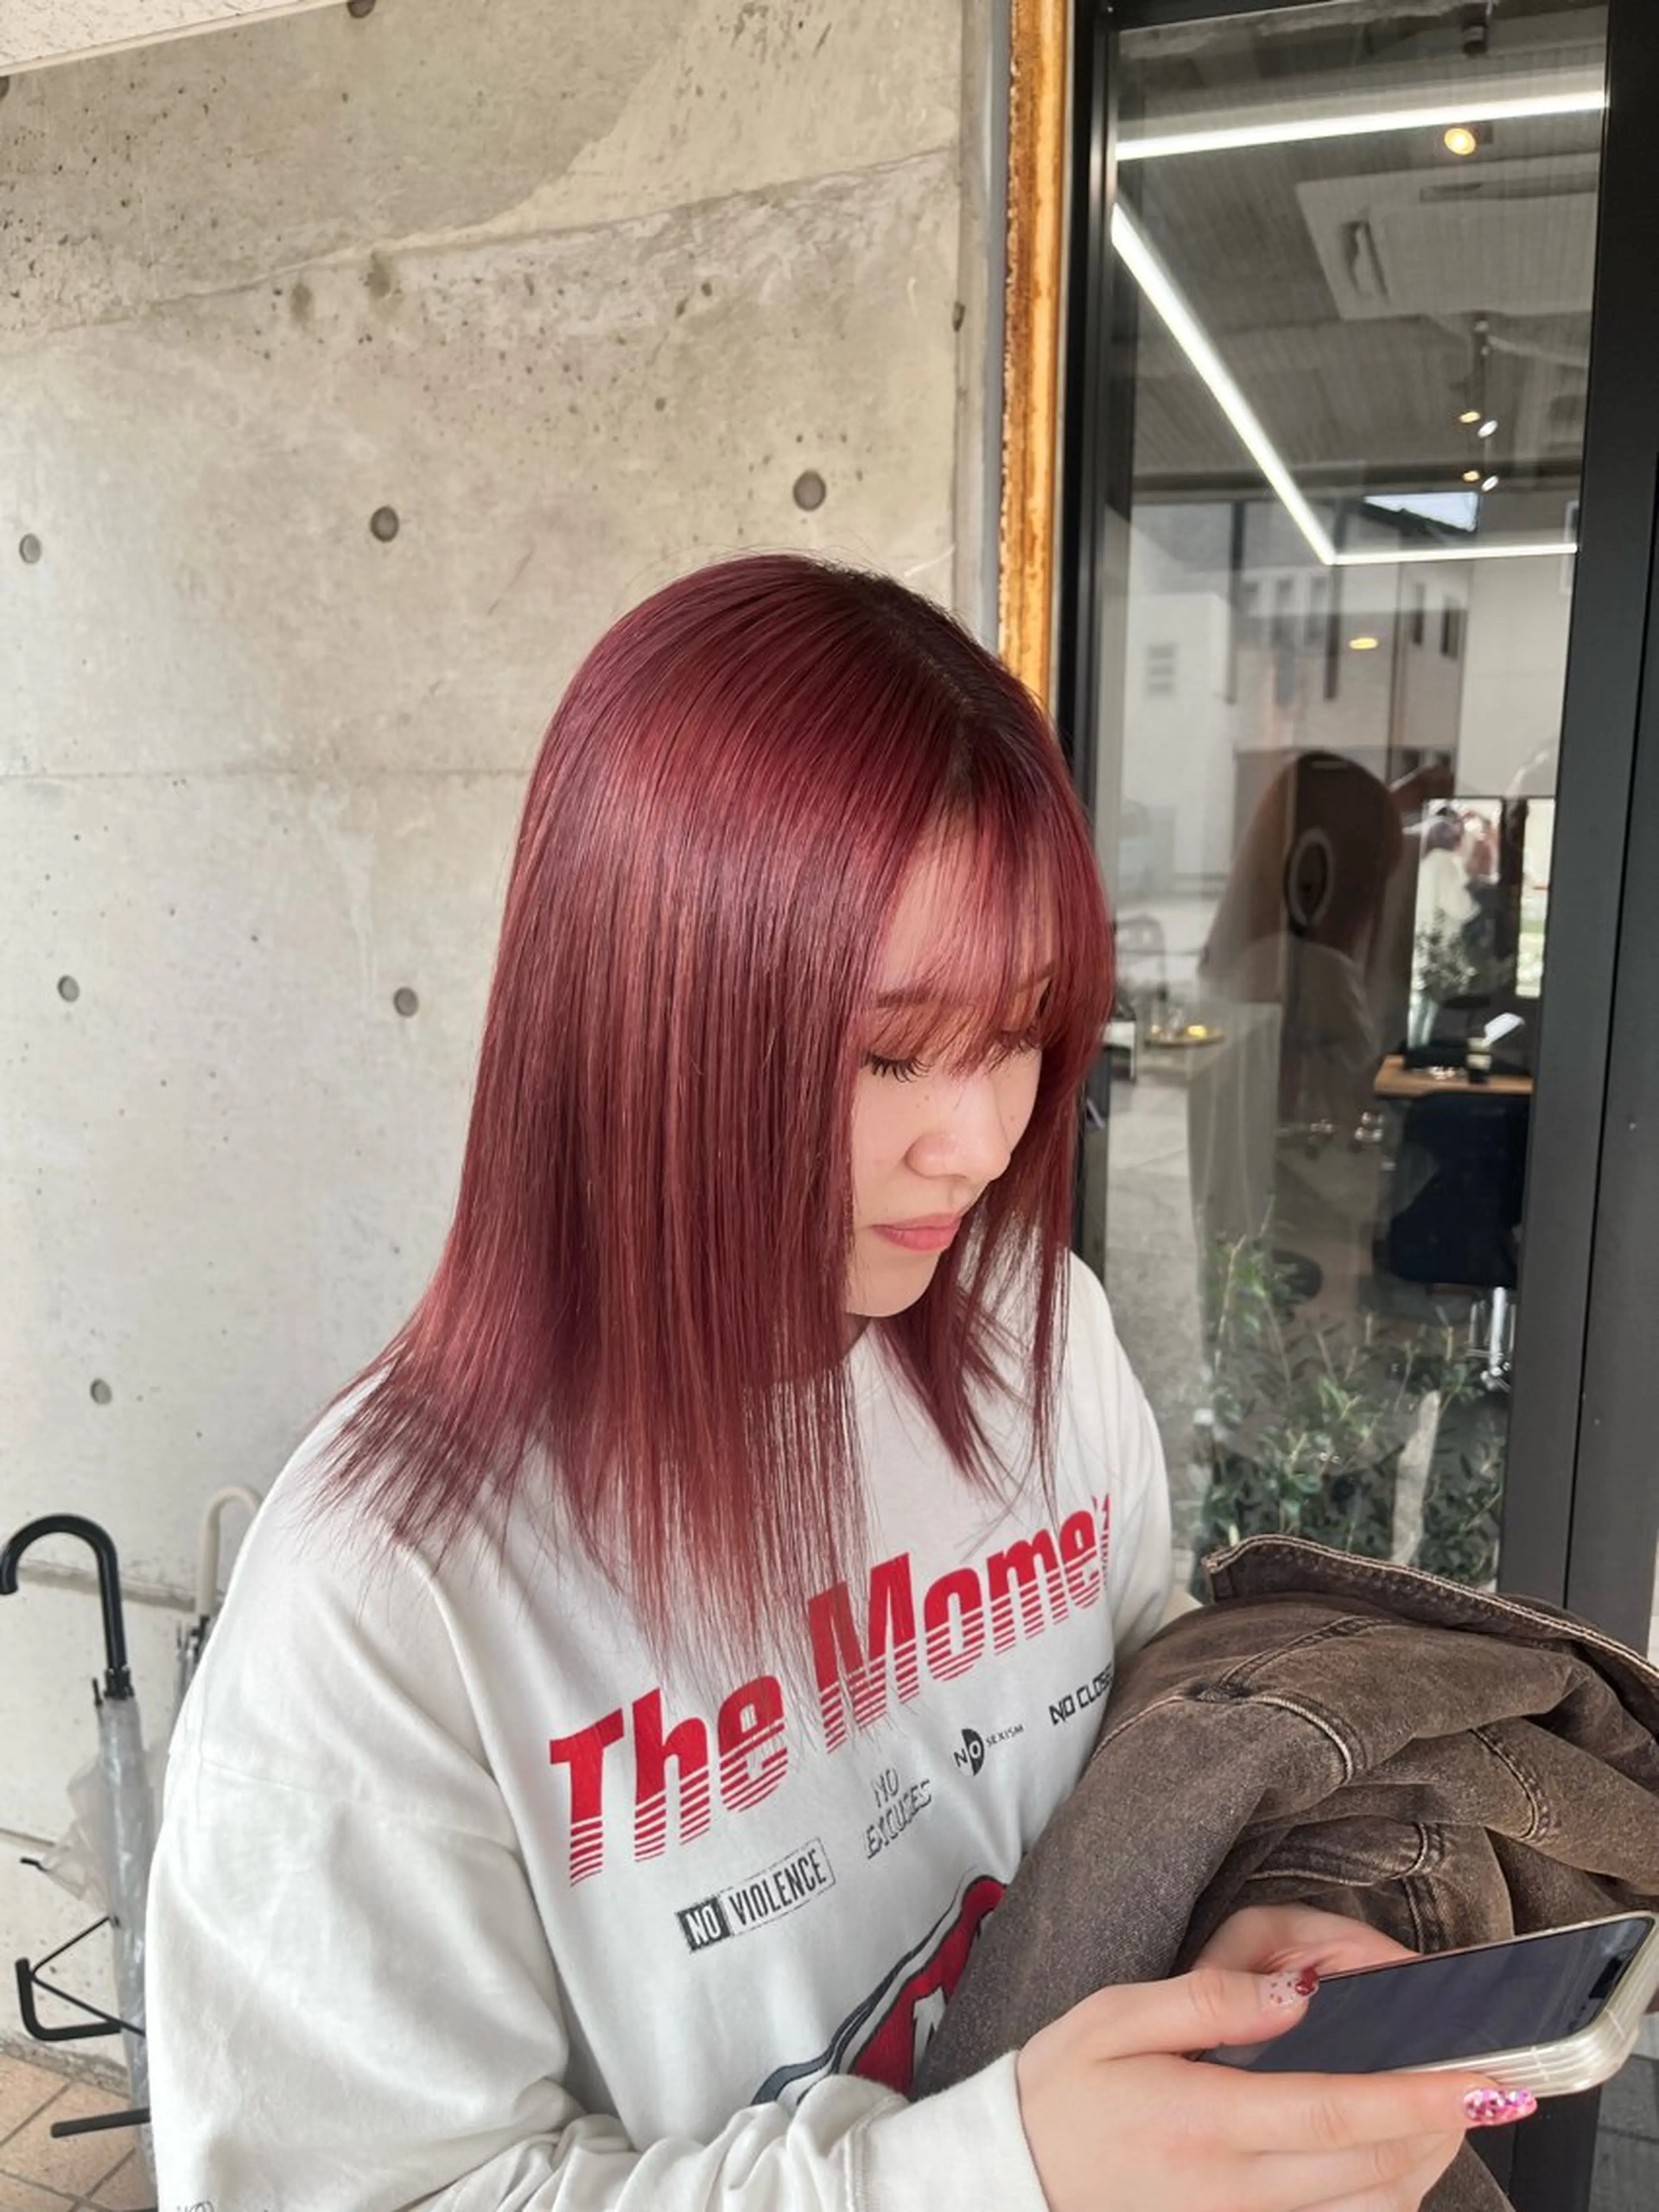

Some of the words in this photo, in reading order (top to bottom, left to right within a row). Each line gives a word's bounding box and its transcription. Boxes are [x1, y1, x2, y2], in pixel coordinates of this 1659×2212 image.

[985, 1723, 1024, 1748] SEXISM
[1049, 1694, 1076, 1726] NO
[550, 1675, 788, 1887] The
[866, 1779, 931, 1859] EXCUSES
[686, 1904, 721, 1945] NO
[728, 1848, 826, 1926] VIOLENCE
